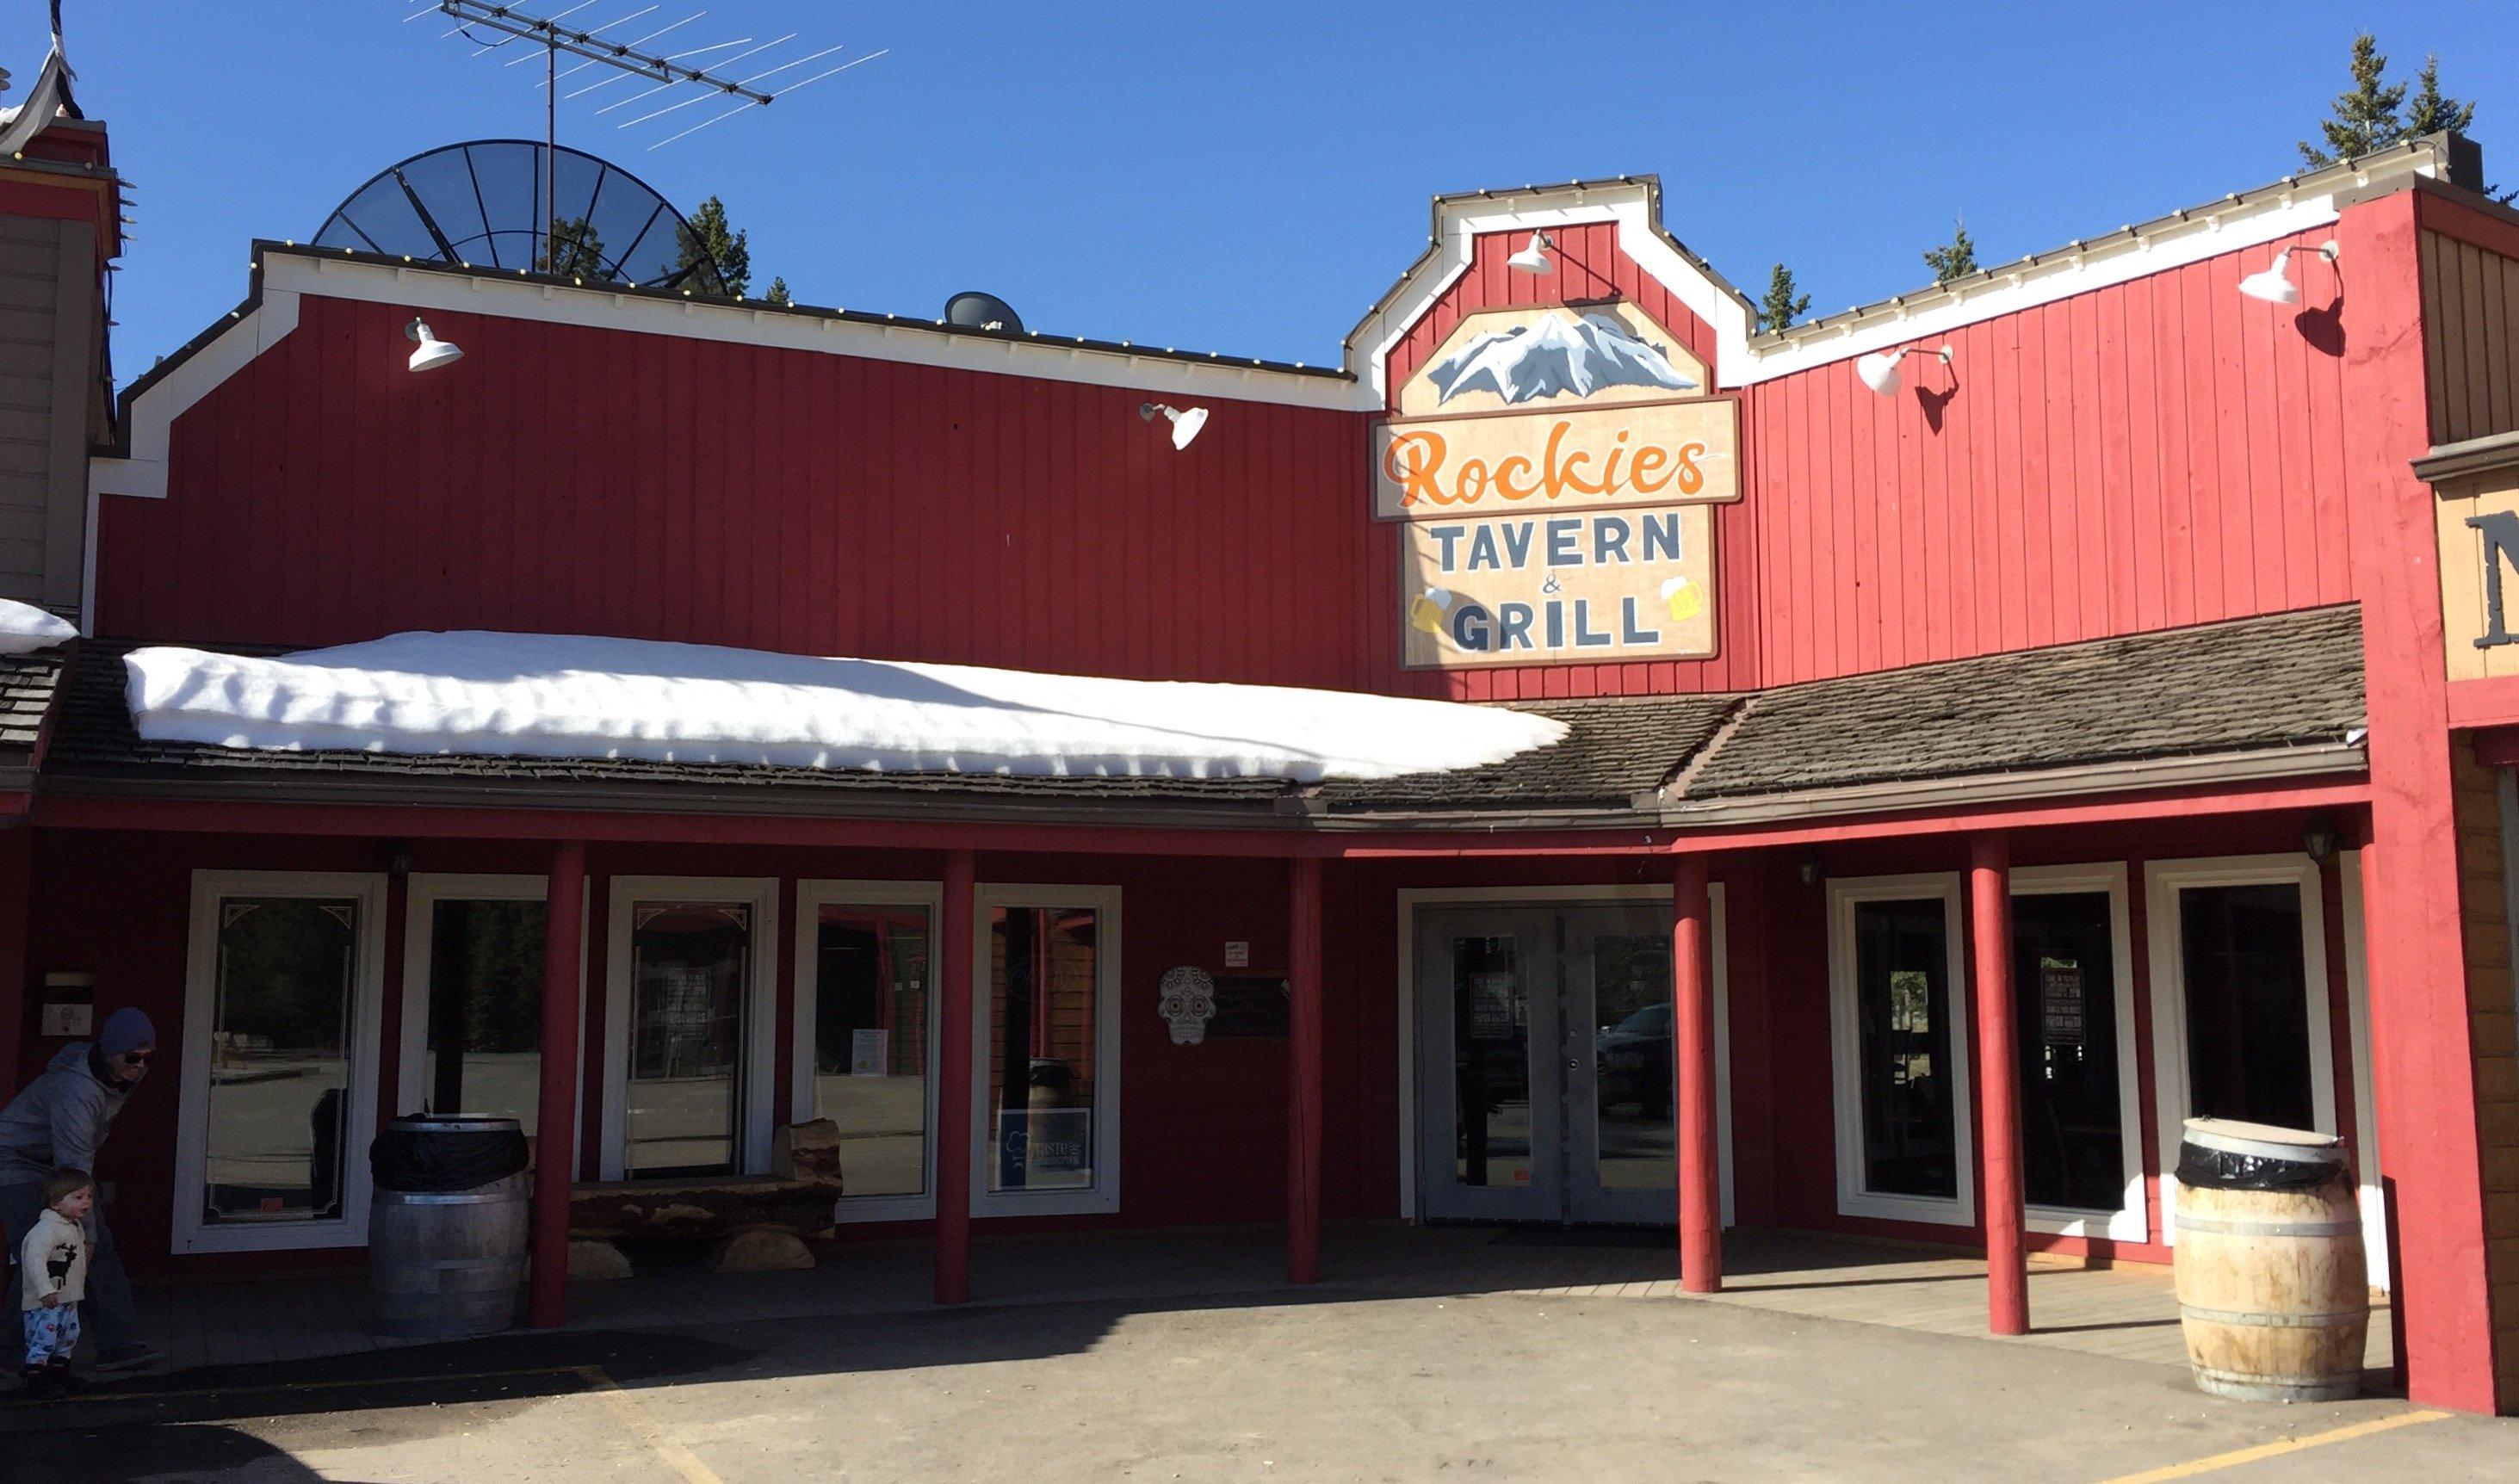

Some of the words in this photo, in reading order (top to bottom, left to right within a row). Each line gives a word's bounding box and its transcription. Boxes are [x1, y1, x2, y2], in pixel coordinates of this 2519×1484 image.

[1383, 421, 1705, 507] Rockies
[1430, 513, 1681, 572] TAVERN
[1542, 573, 1563, 594] &
[1452, 597, 1660, 652] GRILL
